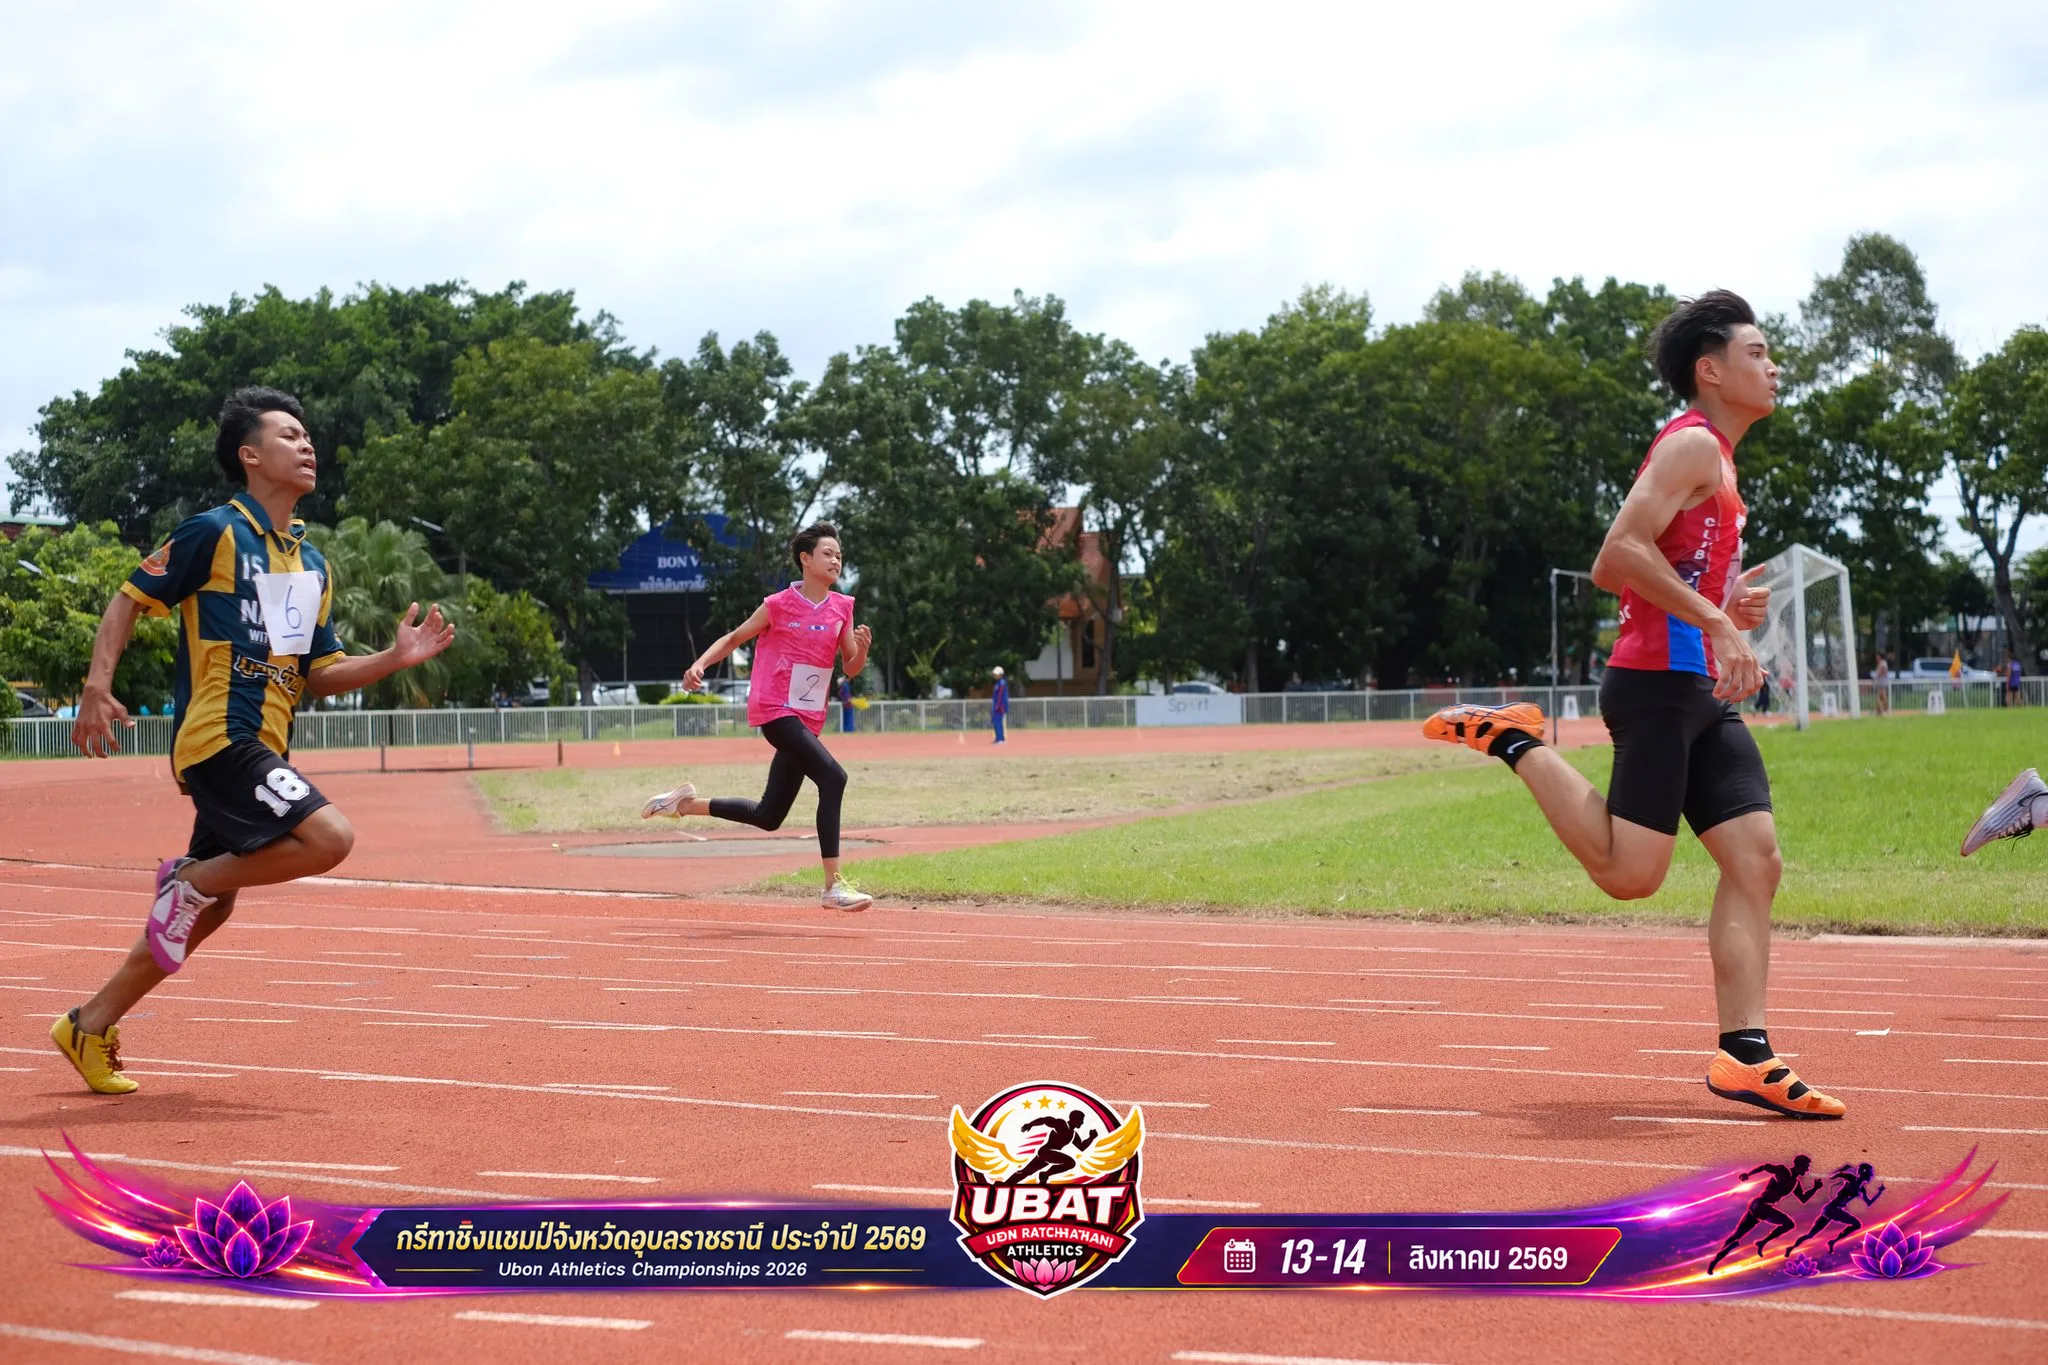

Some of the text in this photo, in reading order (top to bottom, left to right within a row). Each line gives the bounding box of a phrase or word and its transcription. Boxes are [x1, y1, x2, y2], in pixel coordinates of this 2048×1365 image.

[657, 556, 688, 569] BON
[285, 585, 302, 630] 6
[799, 674, 820, 702] 2
[255, 768, 310, 817] 18
